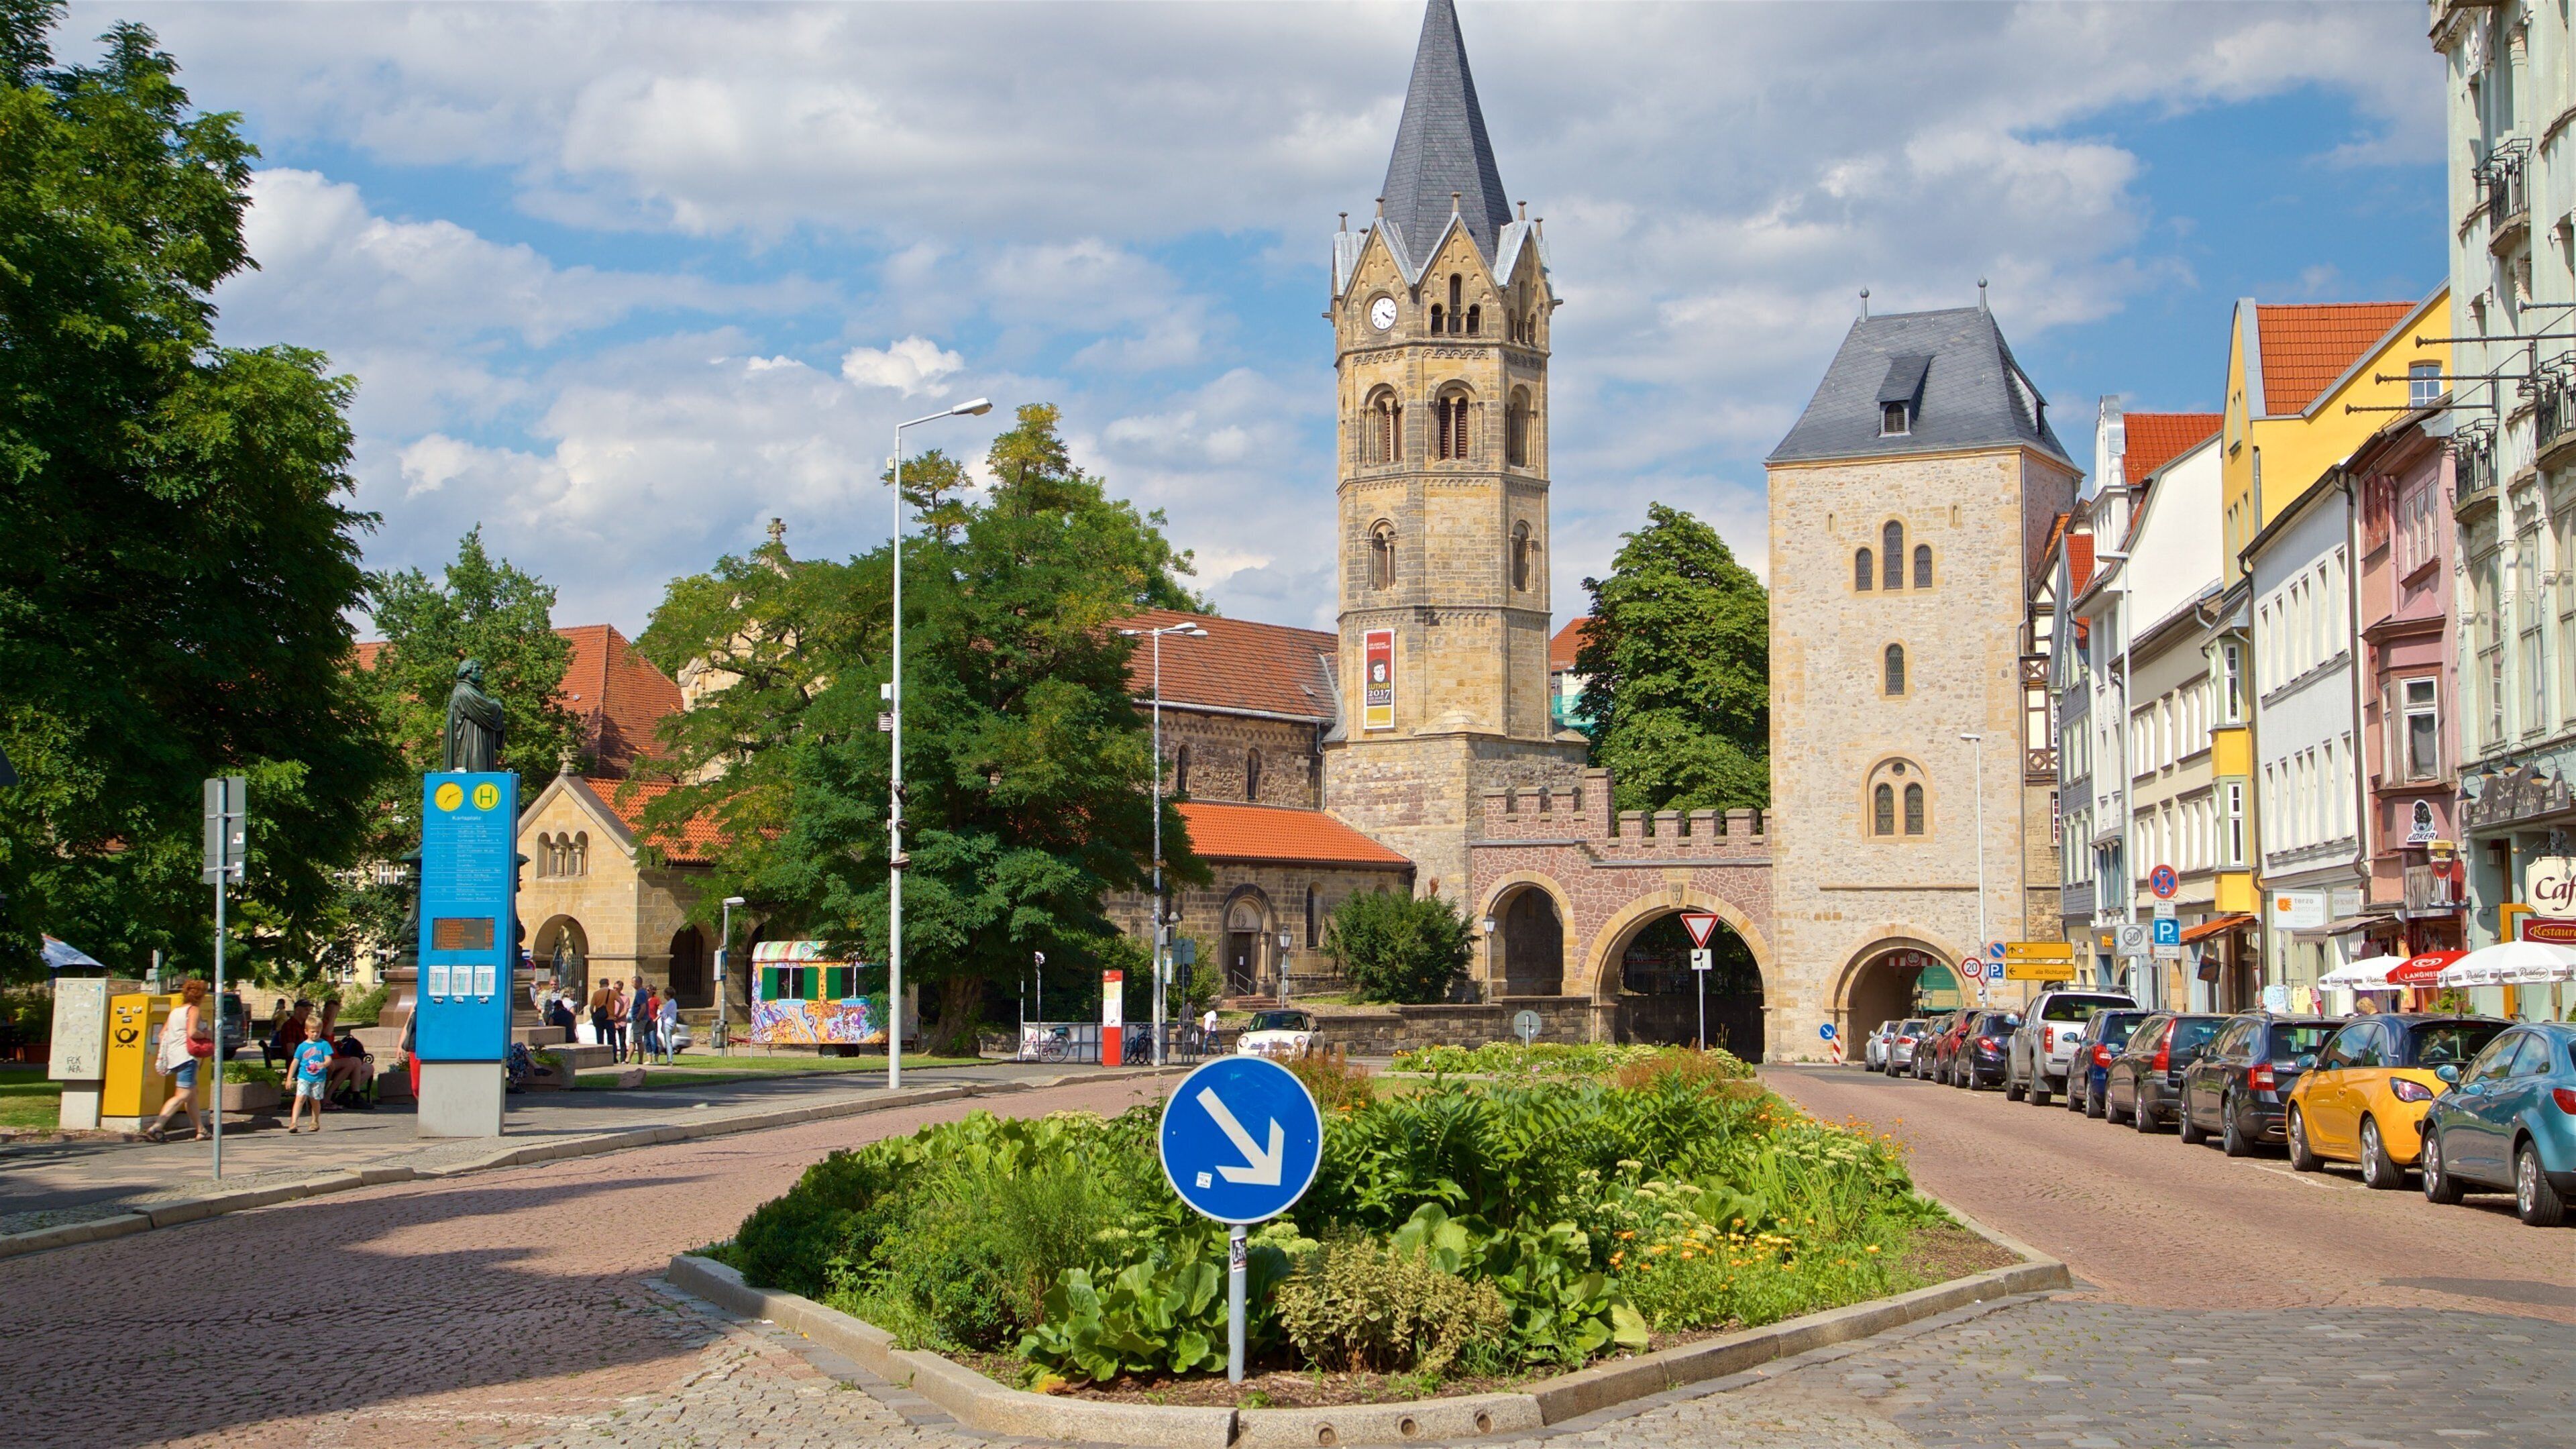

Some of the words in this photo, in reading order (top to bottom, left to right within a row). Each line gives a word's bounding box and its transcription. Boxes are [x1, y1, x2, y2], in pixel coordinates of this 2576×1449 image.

[1368, 690, 1390, 699] 2017
[480, 788, 492, 804] H
[2127, 932, 2139, 942] 30
[2160, 923, 2174, 941] P
[1966, 963, 1978, 972] 20
[1990, 965, 1999, 976] P
[67, 1056, 81, 1065] FCK
